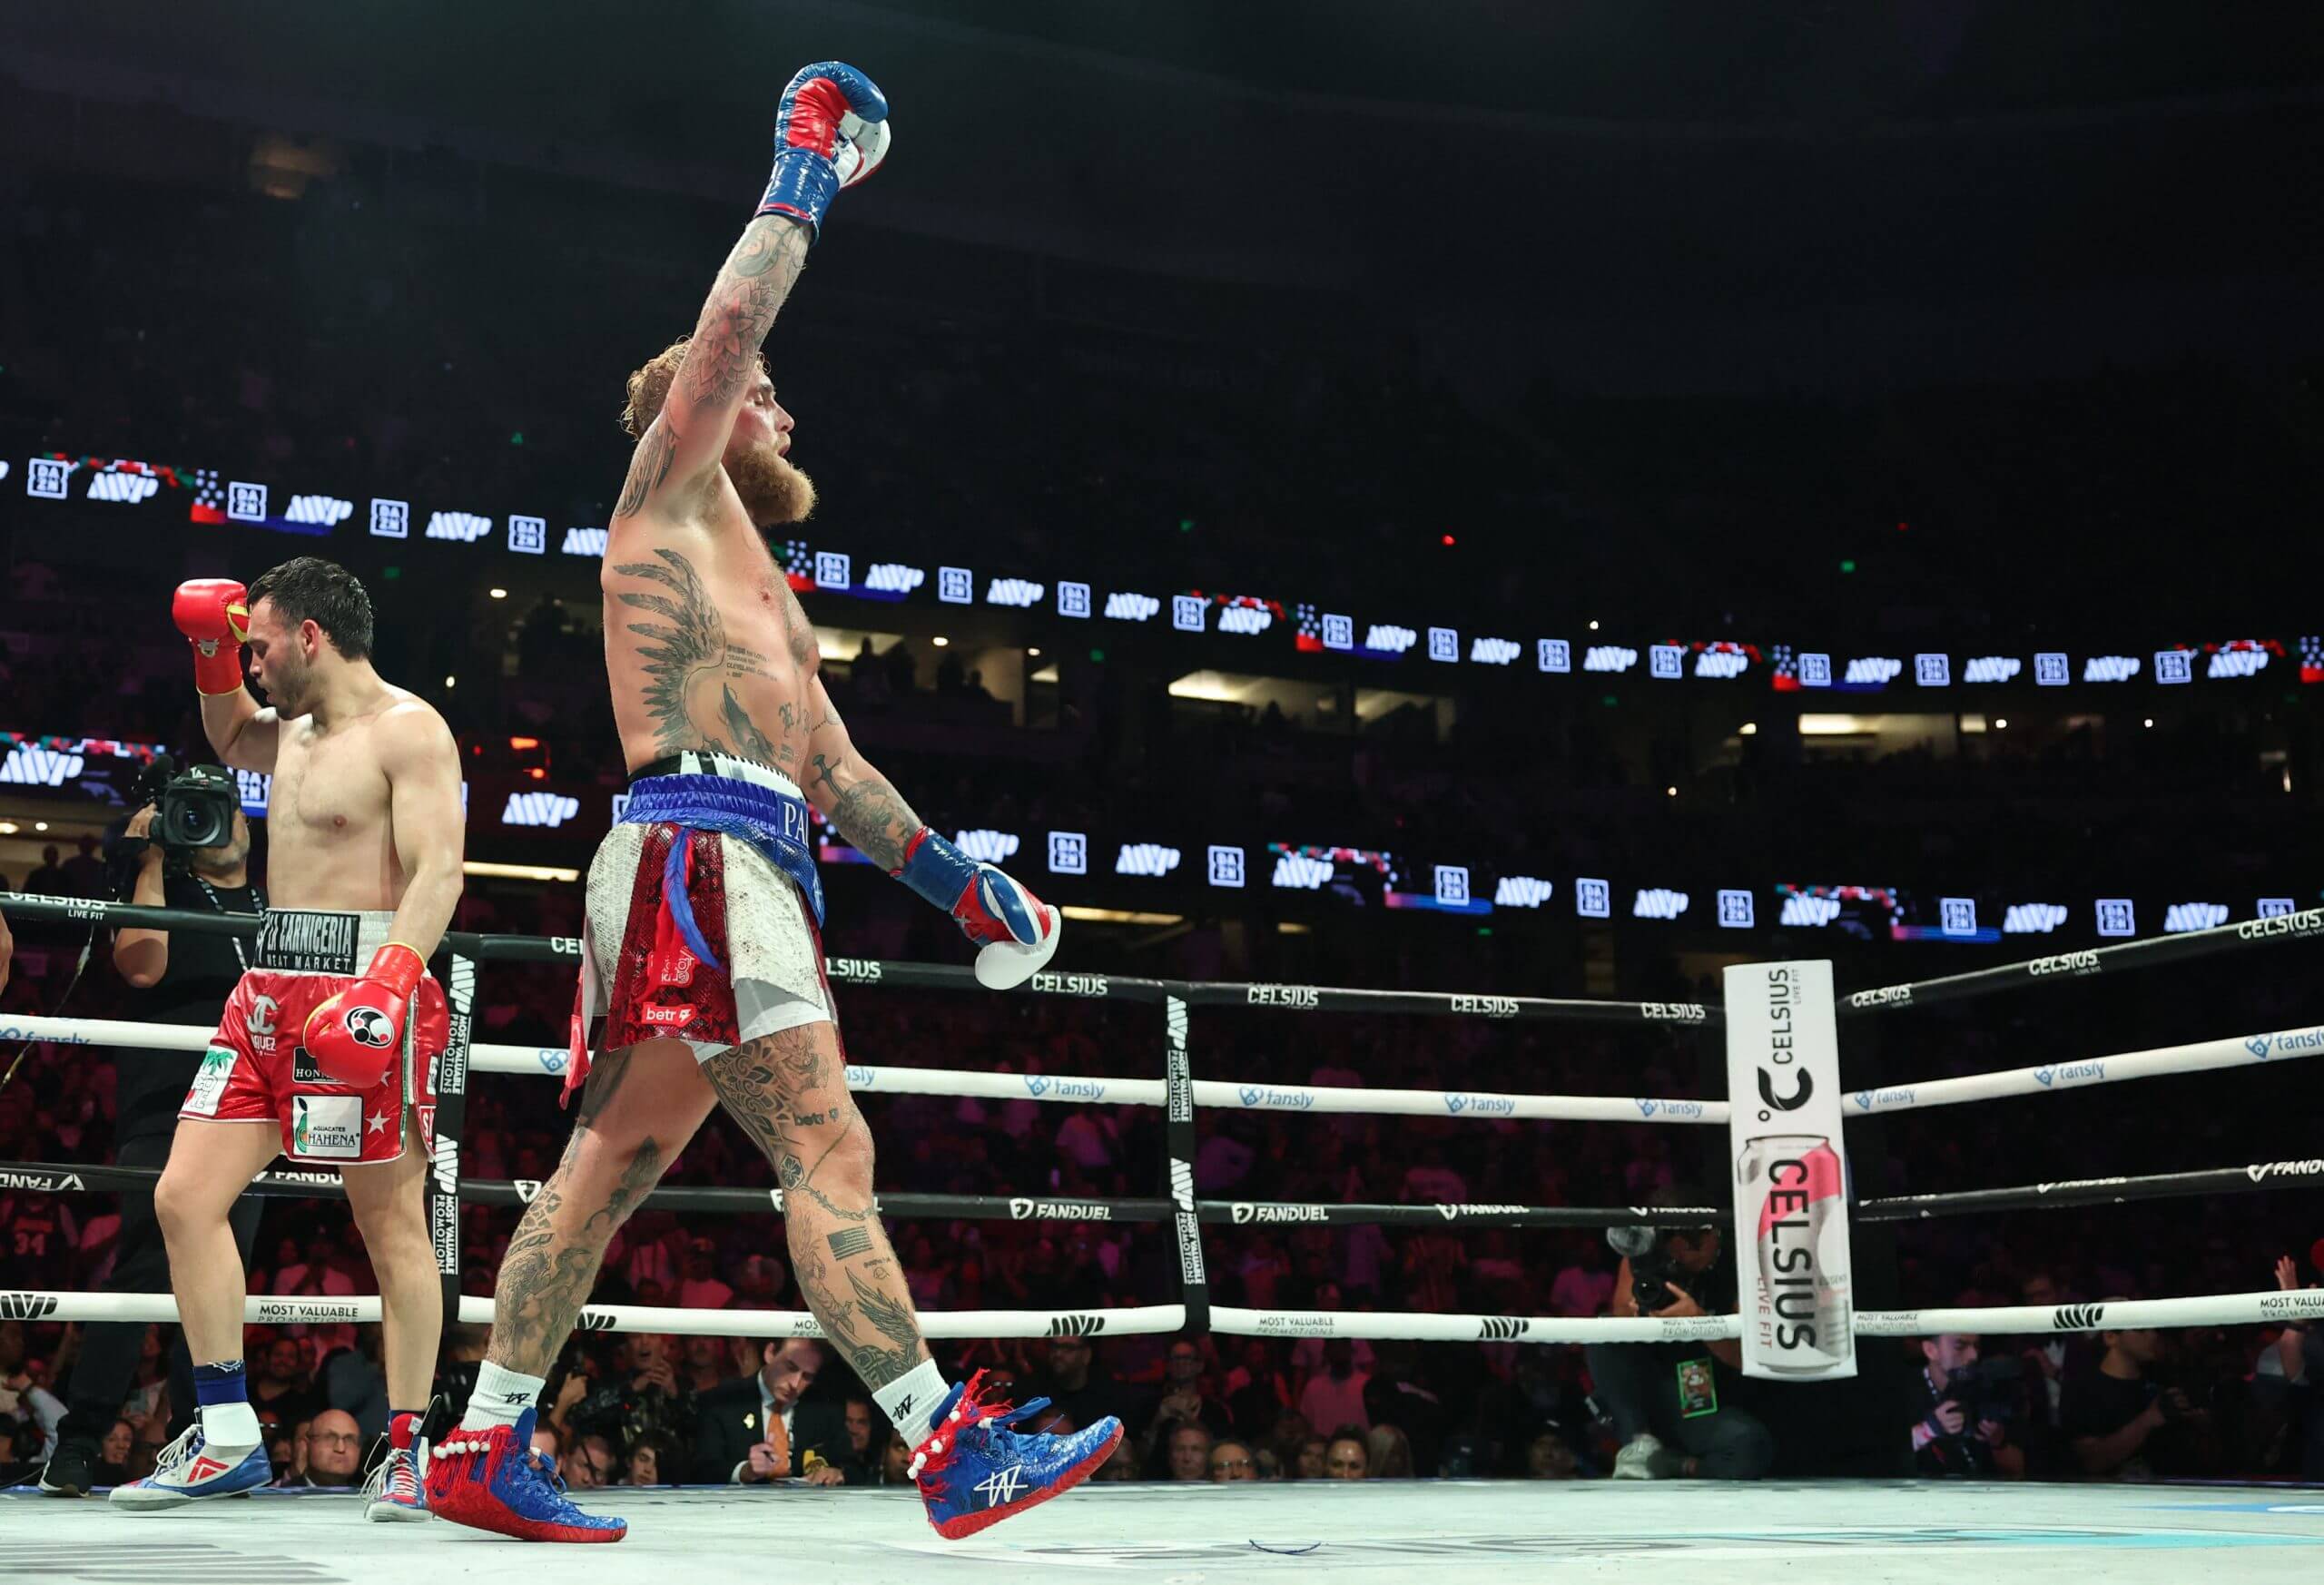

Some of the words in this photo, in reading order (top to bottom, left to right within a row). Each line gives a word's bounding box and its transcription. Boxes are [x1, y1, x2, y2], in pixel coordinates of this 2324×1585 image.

[783, 802, 809, 849] PA
[68, 909, 87, 919] LIVE
[90, 911, 104, 920] FIT
[2238, 910, 2321, 940] CELSIUS
[279, 914, 352, 955] CARNICERIA
[267, 954, 288, 967] MEAT
[294, 955, 351, 971] MARKET
[824, 958, 882, 979] LSIUS
[2029, 949, 2098, 976] CELSIUS
[1032, 973, 1108, 996] CELSIUS
[1851, 984, 1912, 1008] CELSIUS
[1247, 987, 1319, 1006] CELSIUS
[1452, 996, 1519, 1013] CELSIUS
[645, 1008, 676, 1021] betr
[1641, 1002, 1706, 1019] CELSIUS
[1768, 969, 1793, 1064] CELSIUS
[458, 1015, 468, 1045] MOST
[443, 1014, 459, 1094] PROMOTIONS
[1177, 1051, 1187, 1077] MOST
[452, 1046, 466, 1095] VALUABLE
[2061, 1059, 2104, 1081] fansly
[1055, 1079, 1105, 1099] fansly
[1170, 1049, 1182, 1122] PROMOTIONS
[1179, 1078, 1190, 1122] VALUABLE
[1265, 1091, 1314, 1108] fansly
[1471, 1098, 1515, 1115] fansly
[1661, 1100, 1702, 1117] fansly
[275, 1171, 343, 1185] FANDU
[2272, 1159, 2324, 1176] FAND
[445, 1196, 455, 1225] MOST
[1036, 1206, 1111, 1221] FANDUEL
[1256, 1206, 1329, 1222] FANDUEL
[436, 1195, 446, 1274] PROMOTIONS
[1187, 1213, 1196, 1239] MOST
[445, 1226, 455, 1275] VALUABLE
[1178, 1212, 1195, 1285] PROMOTIONS
[1768, 1159, 1817, 1350] CELSIUS
[1190, 1241, 1203, 1285] VALUABLE
[1757, 1277, 1771, 1315] LIVE
[2260, 1297, 2290, 1308] MOST
[260, 1304, 296, 1315] MOST
[299, 1306, 359, 1318] VALUABLE
[1259, 1317, 1285, 1325] MOST
[1289, 1317, 1335, 1326] VALUABLE
[794, 1320, 819, 1330] MOS
[1758, 1321, 1772, 1348] FIT
